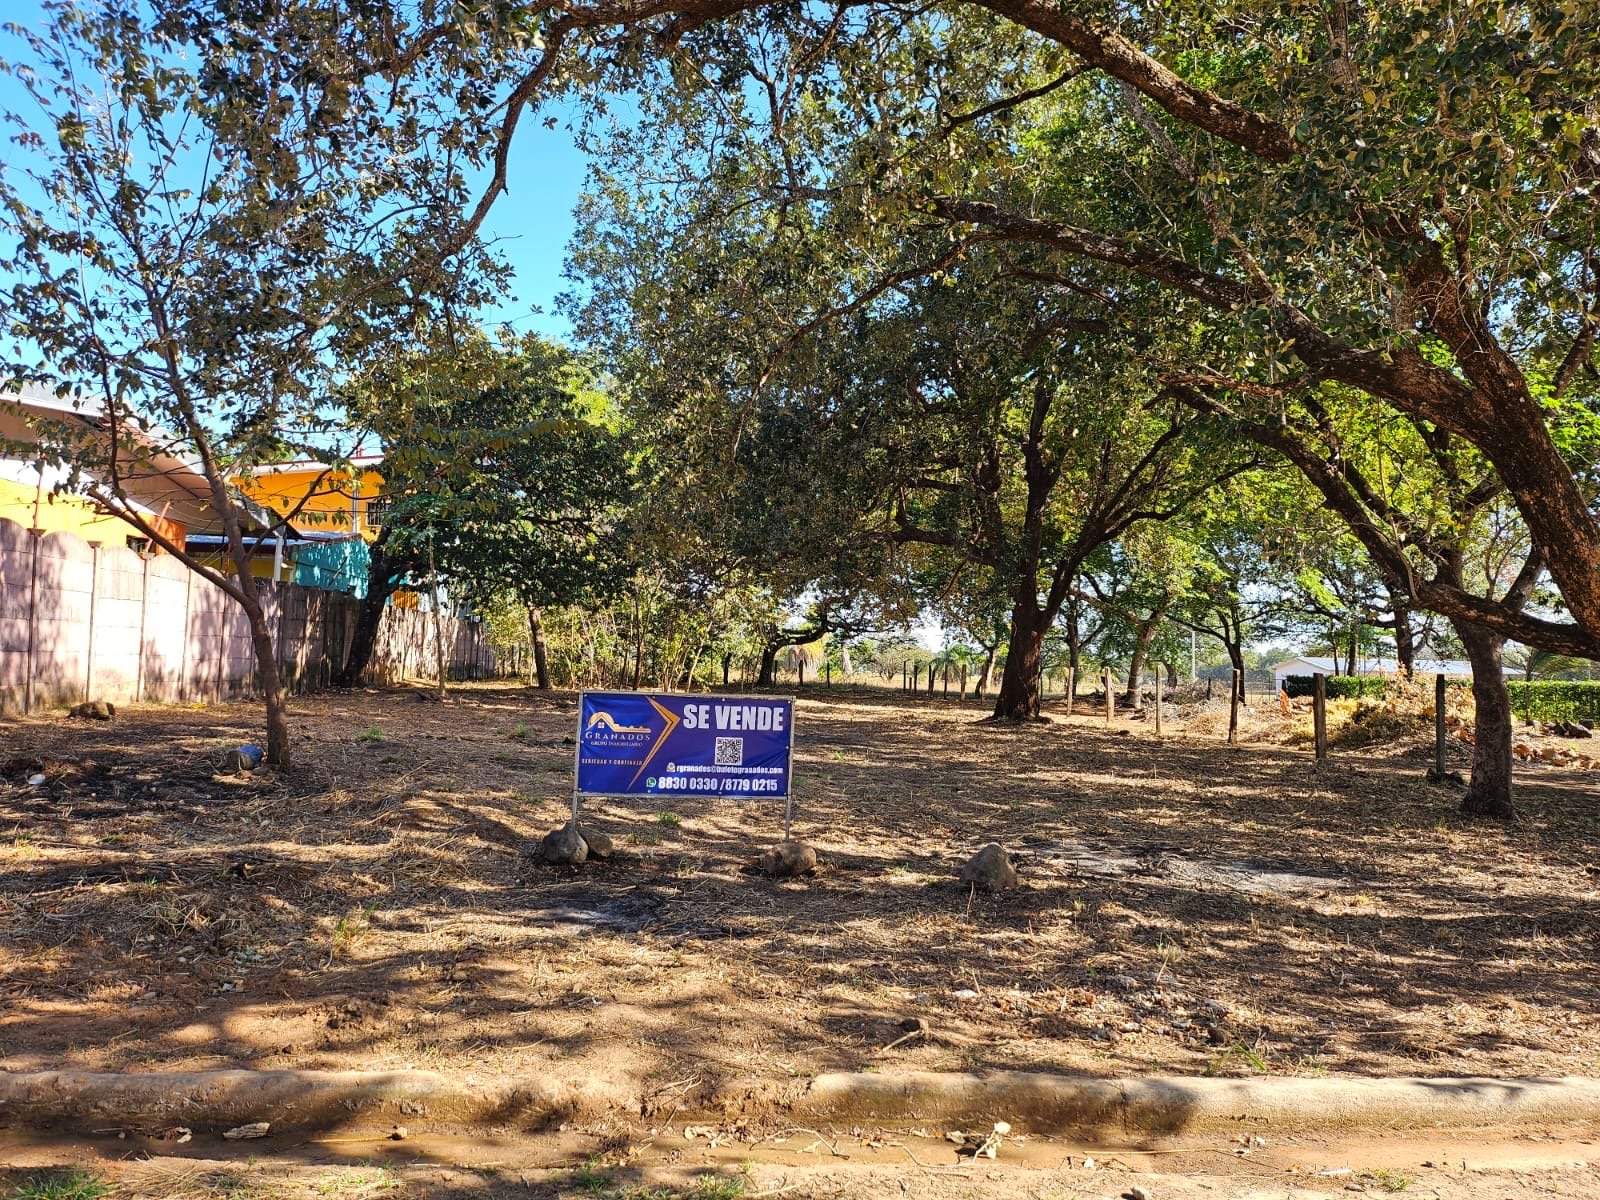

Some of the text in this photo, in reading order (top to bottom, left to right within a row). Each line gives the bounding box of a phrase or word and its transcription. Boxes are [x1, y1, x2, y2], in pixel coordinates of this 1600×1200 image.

[683, 704, 784, 731] SE VENDE
[585, 731, 651, 741] GRANADOS
[658, 777, 687, 790] 8830
[689, 778, 718, 791] 0330
[751, 779, 778, 791] 0215
